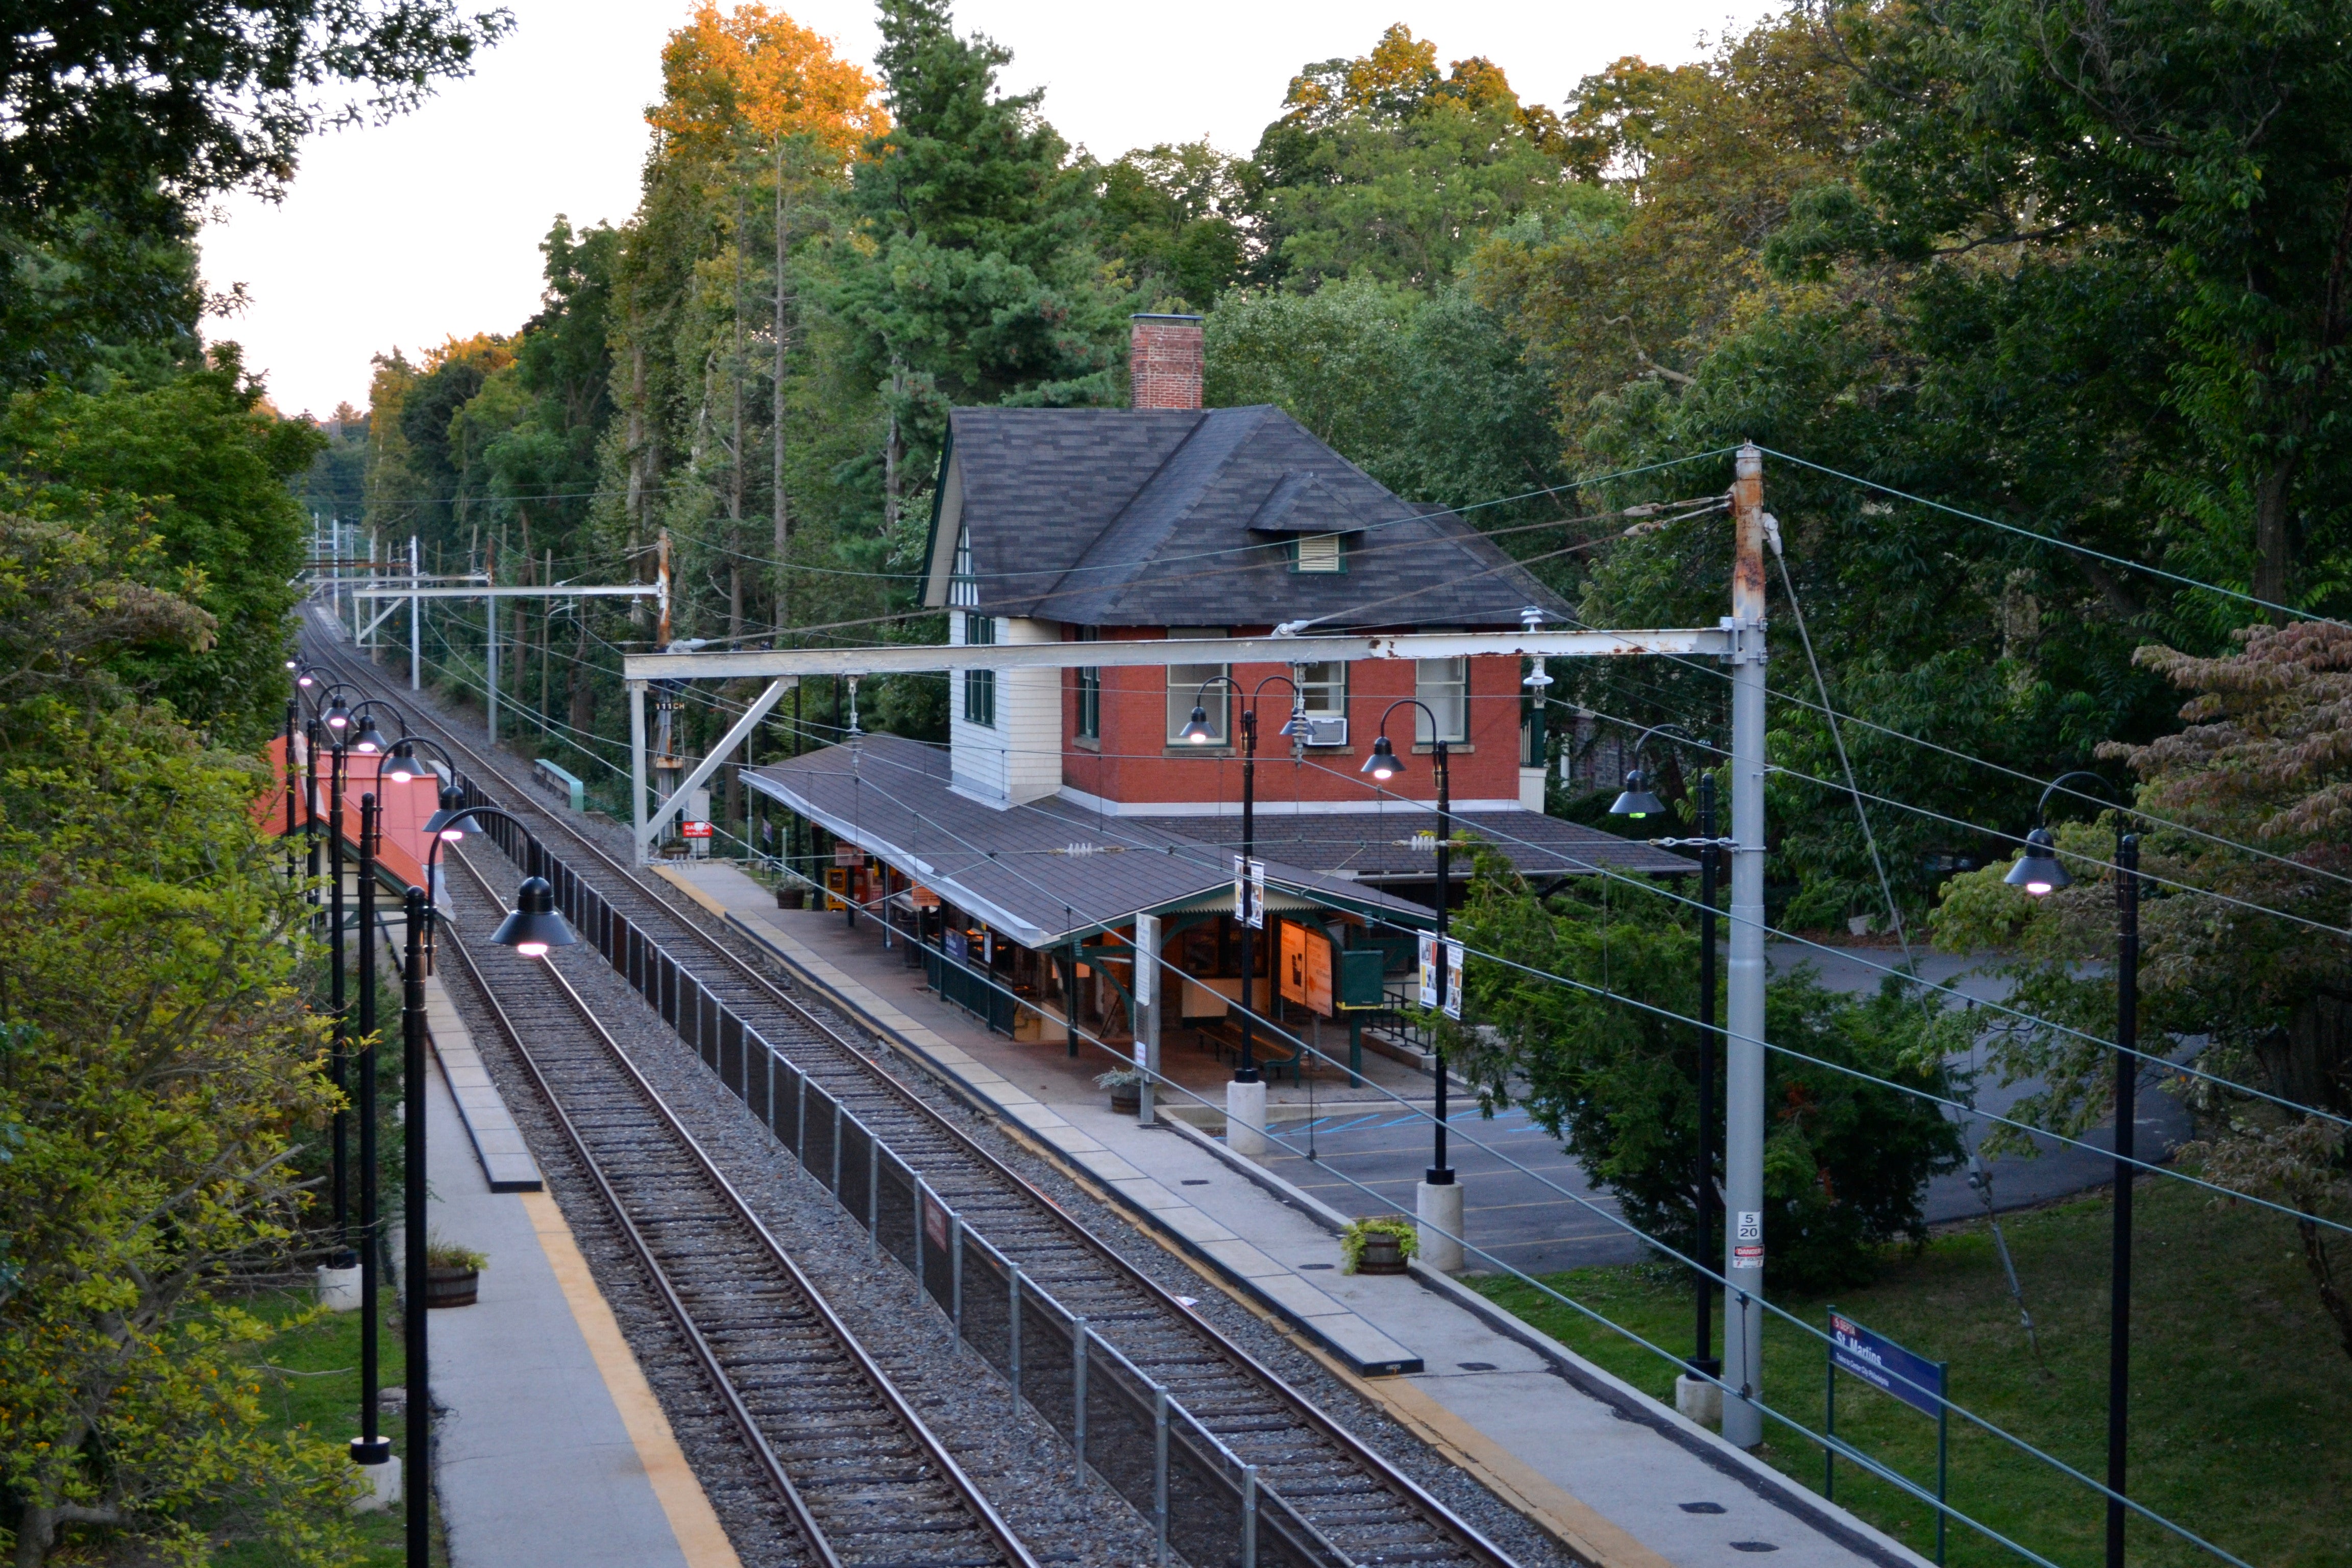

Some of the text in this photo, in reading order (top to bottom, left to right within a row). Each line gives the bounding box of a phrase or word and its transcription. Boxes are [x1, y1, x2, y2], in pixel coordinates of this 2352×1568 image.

[1746, 1215, 1753, 1223] 5
[1741, 1228, 1757, 1237] 20
[1850, 1337, 1881, 1365] Martins
